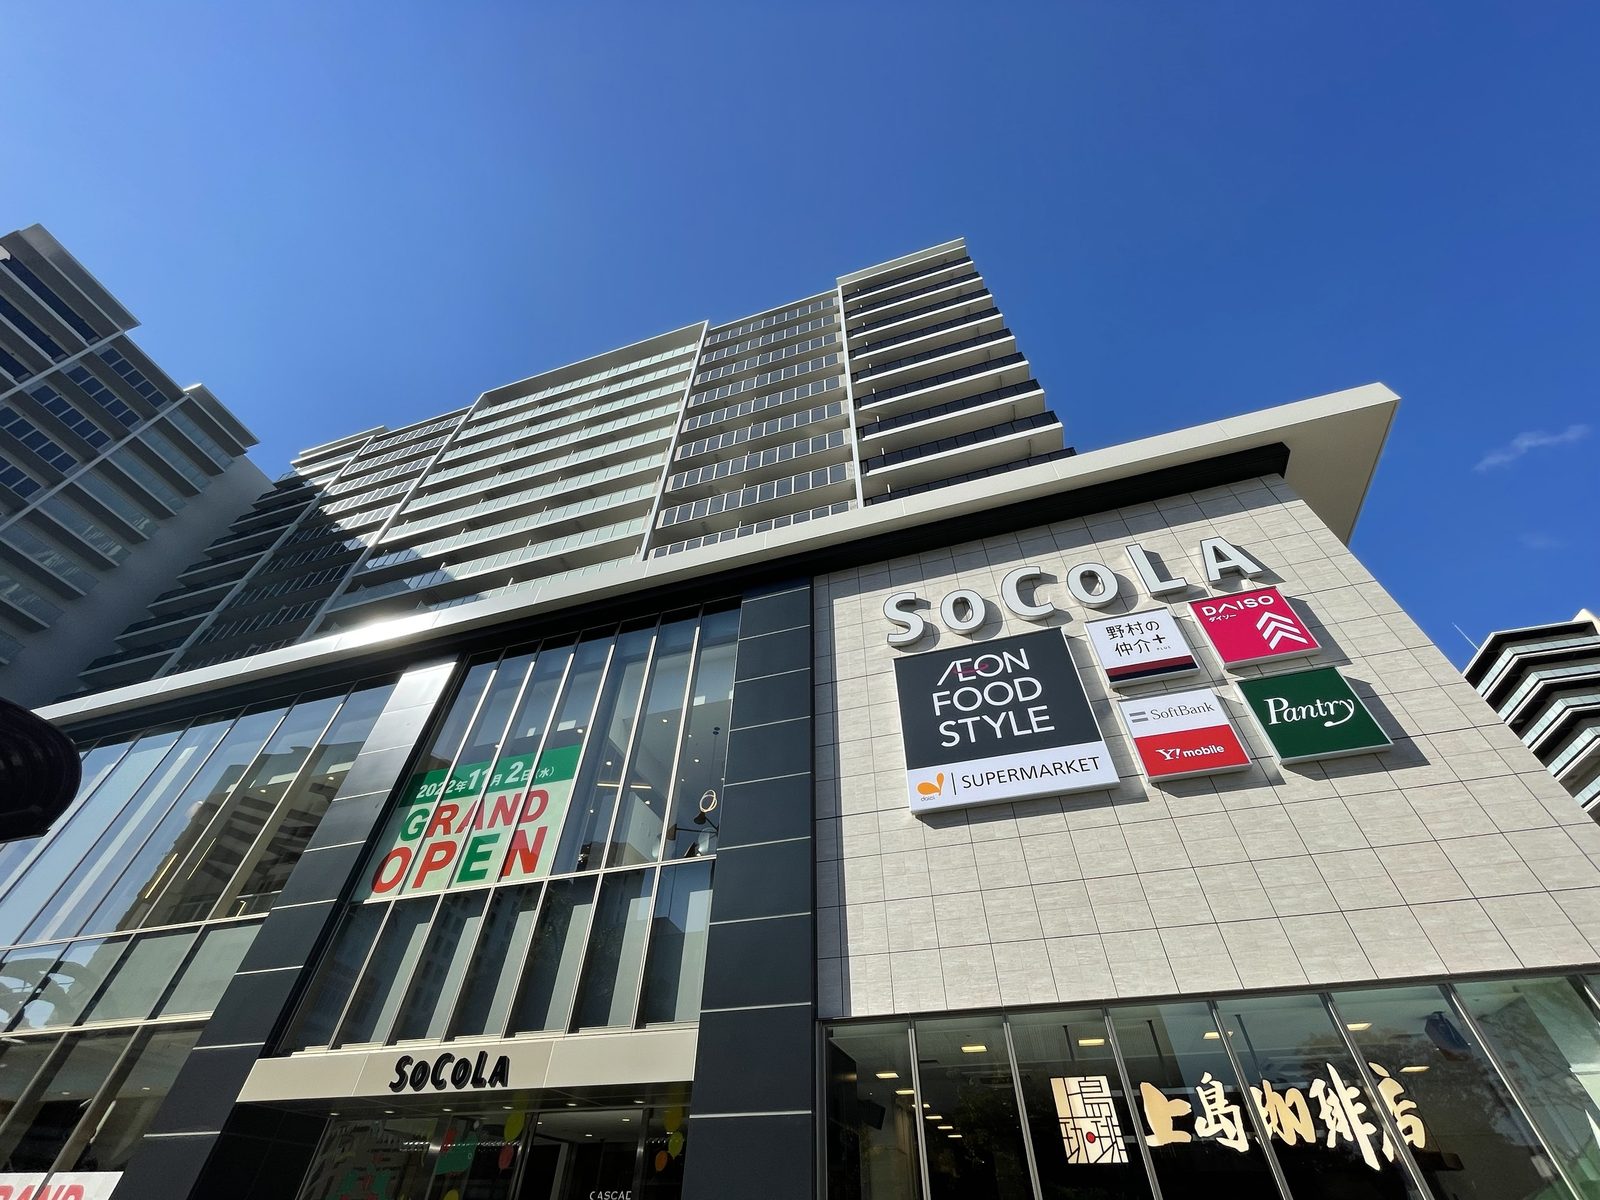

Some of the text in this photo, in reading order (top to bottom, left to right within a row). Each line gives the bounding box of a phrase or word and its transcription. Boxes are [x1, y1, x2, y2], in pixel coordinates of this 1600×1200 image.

[1202, 595, 1275, 617] DAISO
[1209, 613, 1237, 622] ダイソー
[1106, 620, 1160, 640] 野村の
[932, 676, 1042, 716] FOOD
[1150, 702, 1215, 721] SoftBank
[938, 705, 1055, 747] STYLE
[1264, 697, 1355, 728] Pantry
[961, 756, 1100, 789] SUPERMARKET
[400, 789, 549, 842] GRAND
[371, 827, 548, 893] OPEN
